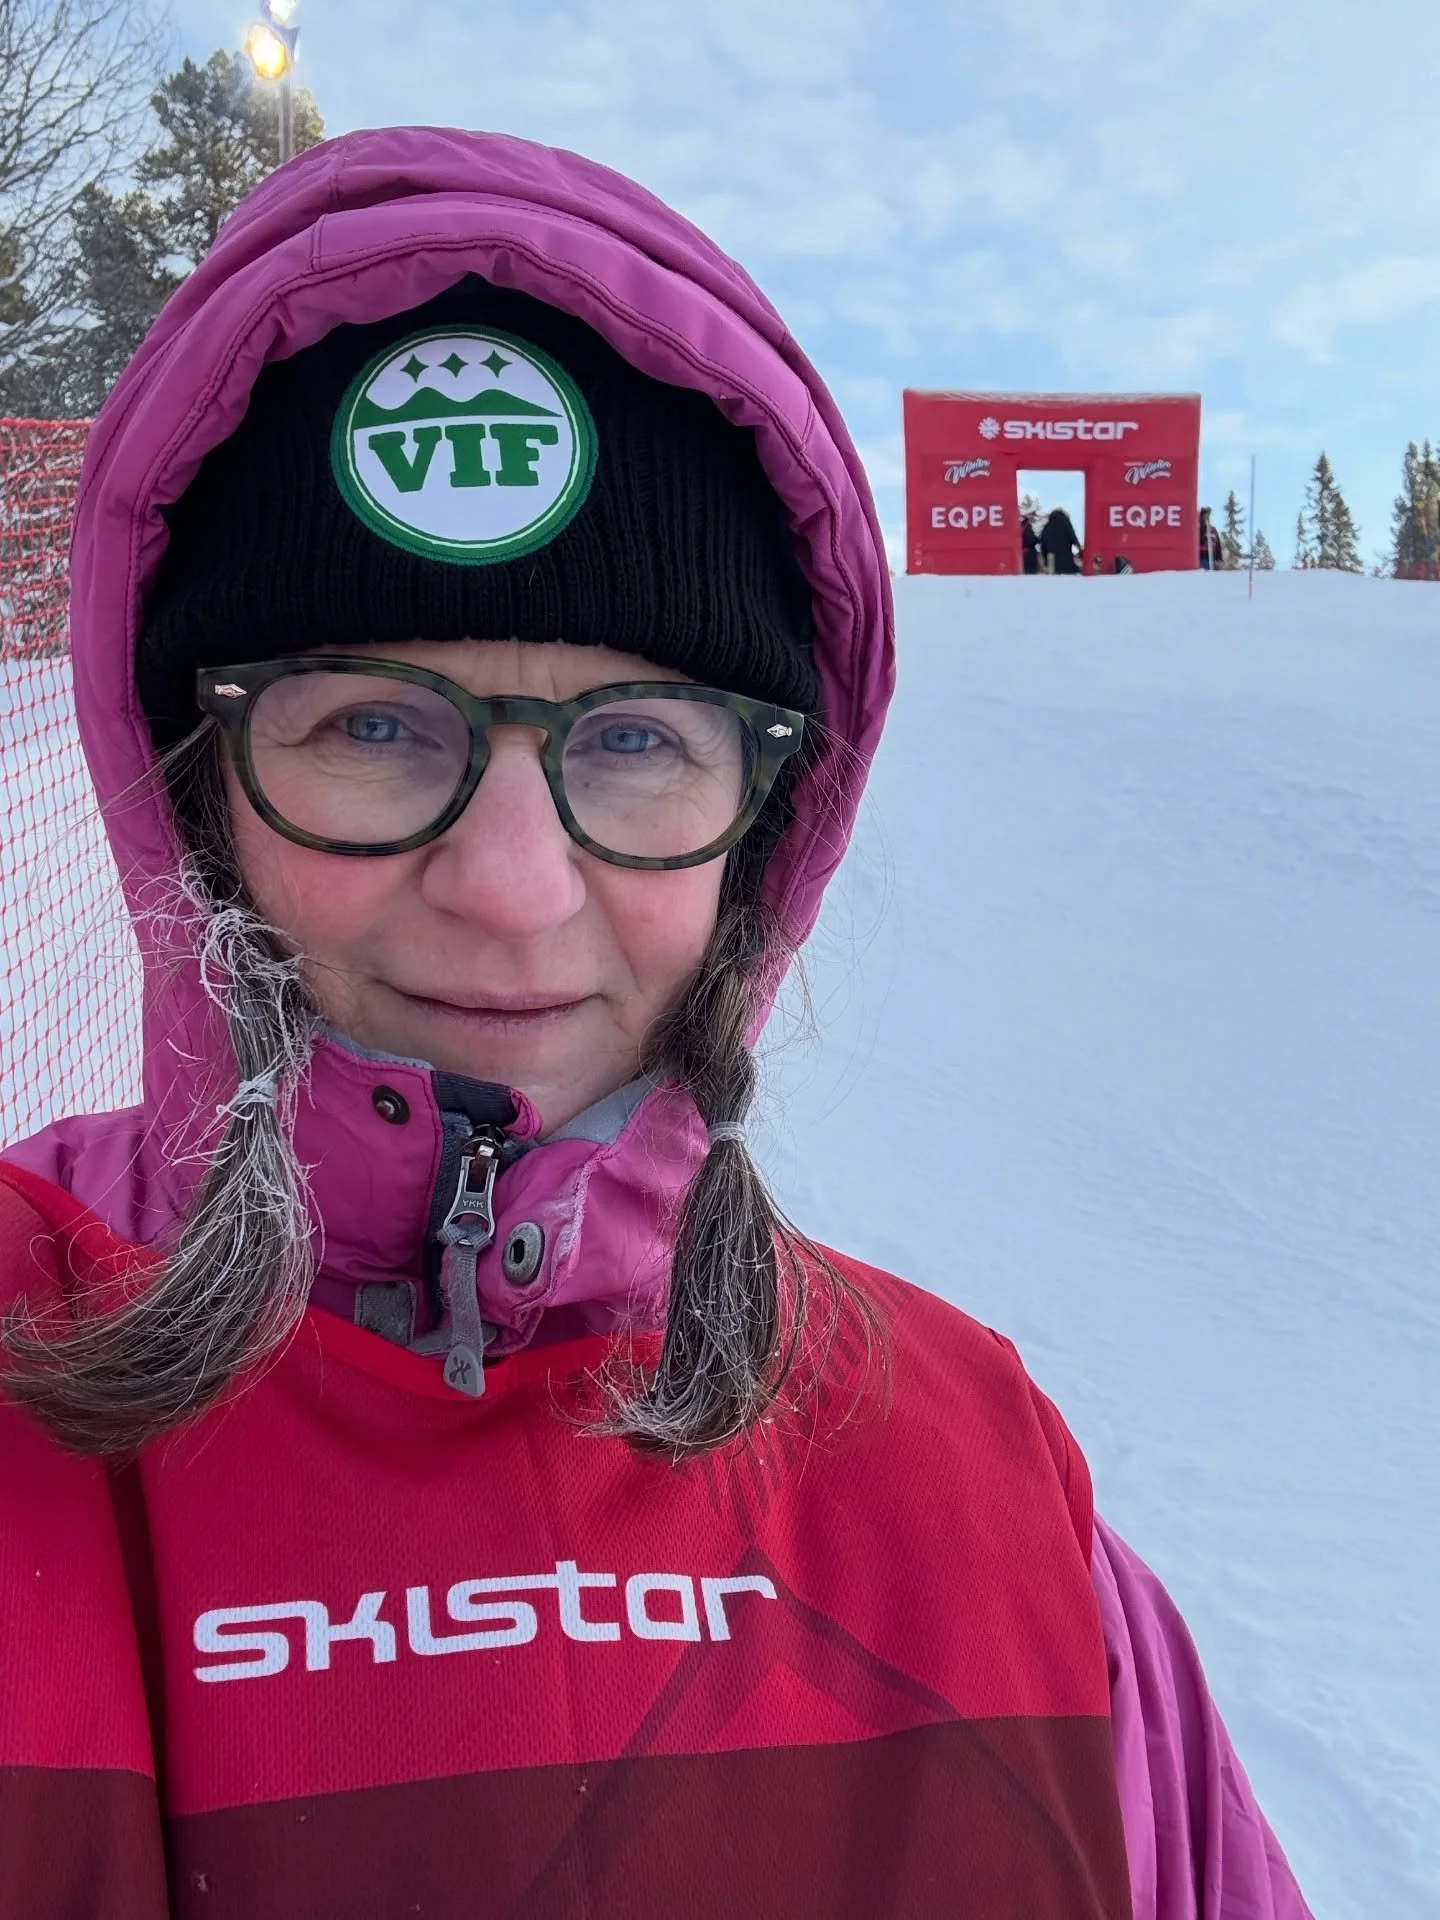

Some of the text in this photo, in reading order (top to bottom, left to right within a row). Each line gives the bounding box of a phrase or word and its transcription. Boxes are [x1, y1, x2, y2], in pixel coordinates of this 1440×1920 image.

[368, 423, 559, 493] VIF
[931, 505, 1004, 530] EQPE
[1109, 505, 1182, 529] EQPE
[462, 1199, 485, 1209] YKK
